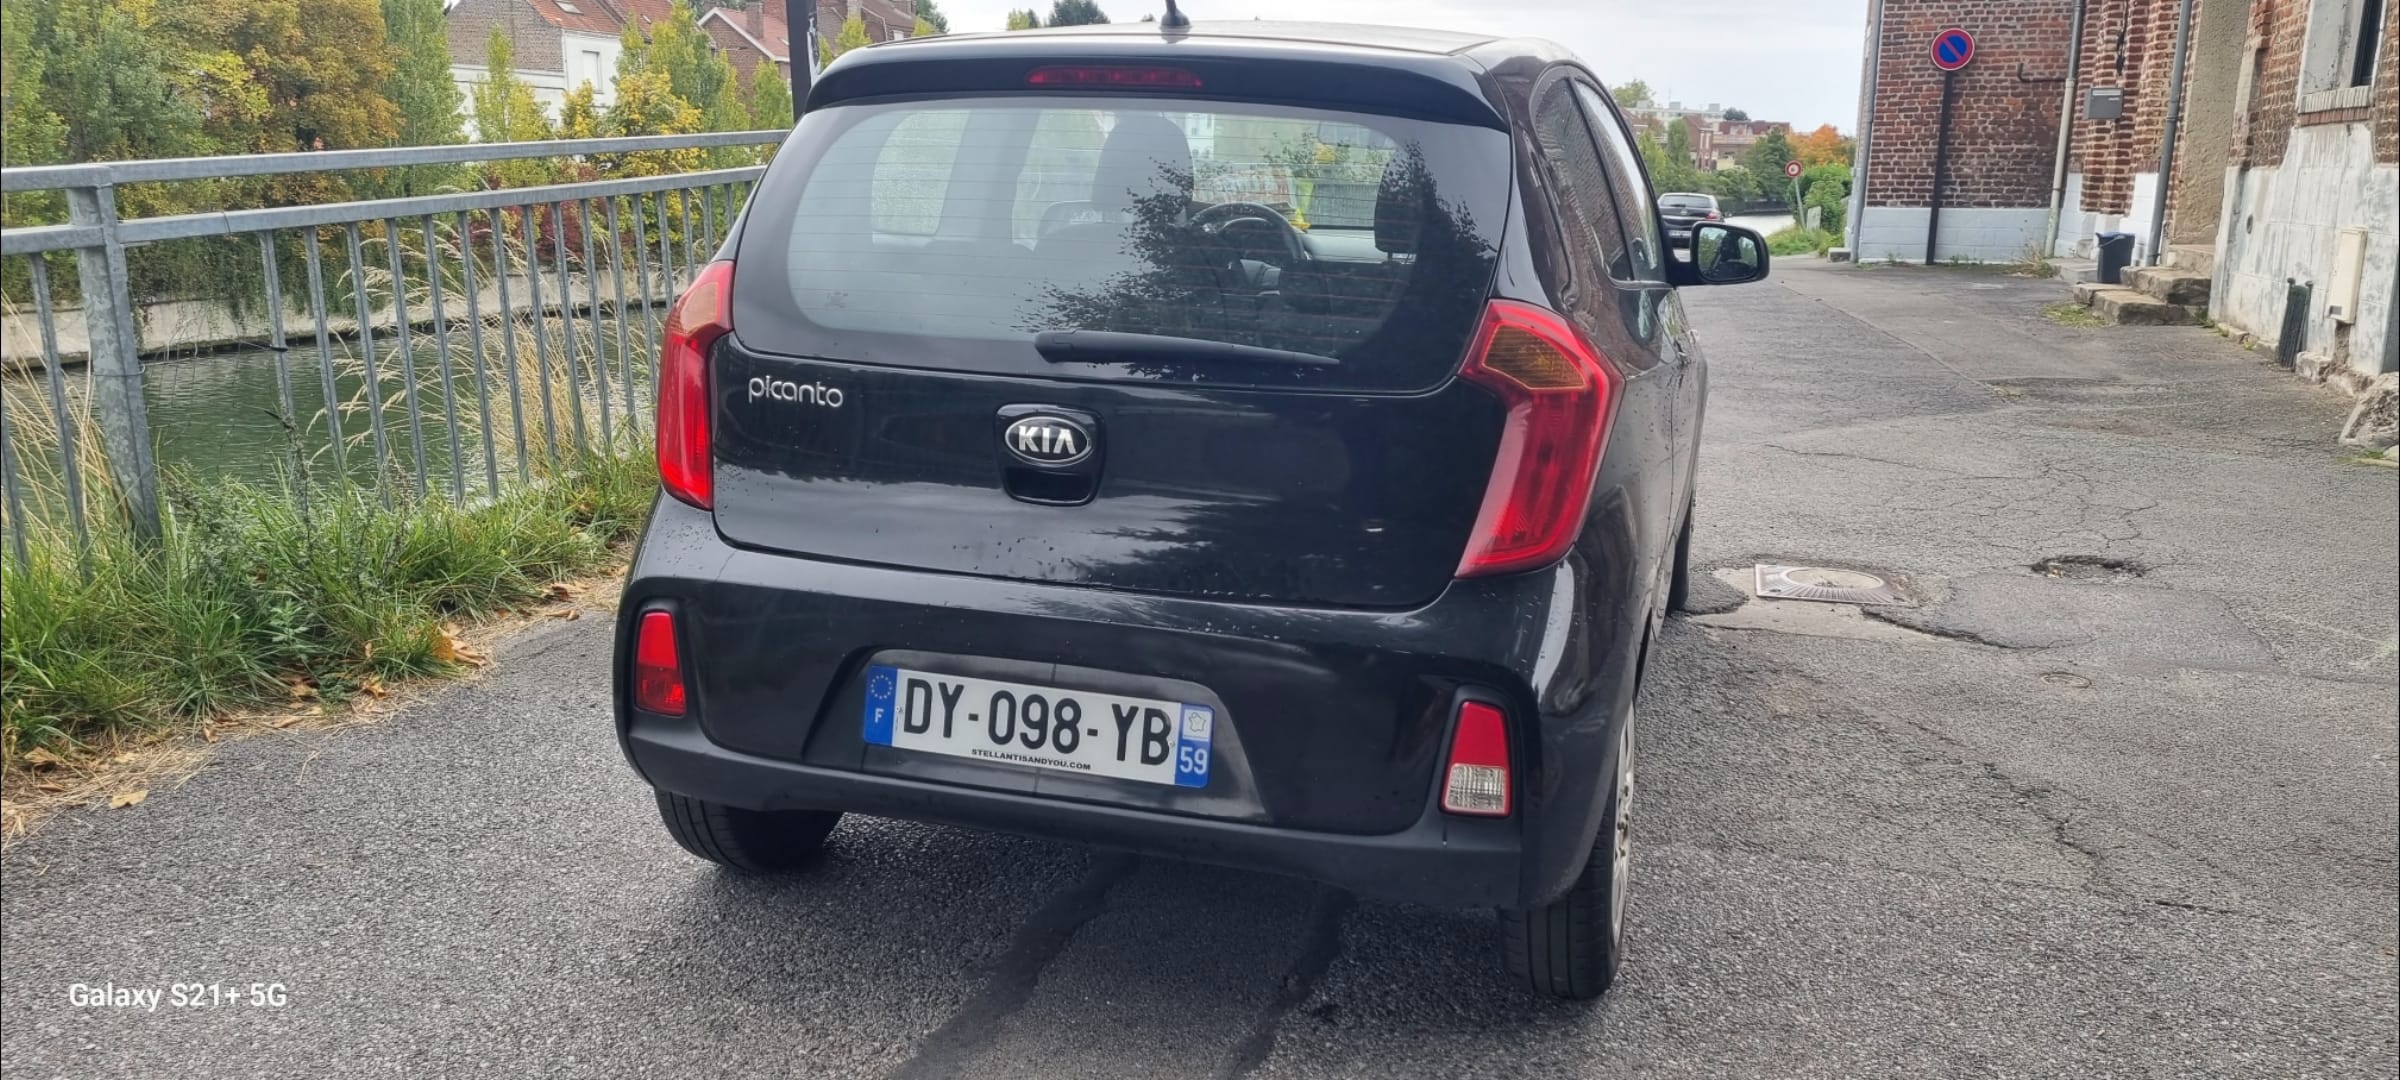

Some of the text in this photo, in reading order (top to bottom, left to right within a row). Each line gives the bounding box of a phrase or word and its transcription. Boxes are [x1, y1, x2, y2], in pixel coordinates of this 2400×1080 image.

[748, 375, 843, 408] picanto
[1017, 426, 1077, 455] KIA
[873, 707, 885, 724] F
[903, 677, 1172, 767] DY-098-YB
[971, 748, 1091, 771] STELLANTISANDYOU.COM
[1179, 746, 1208, 775] 59
